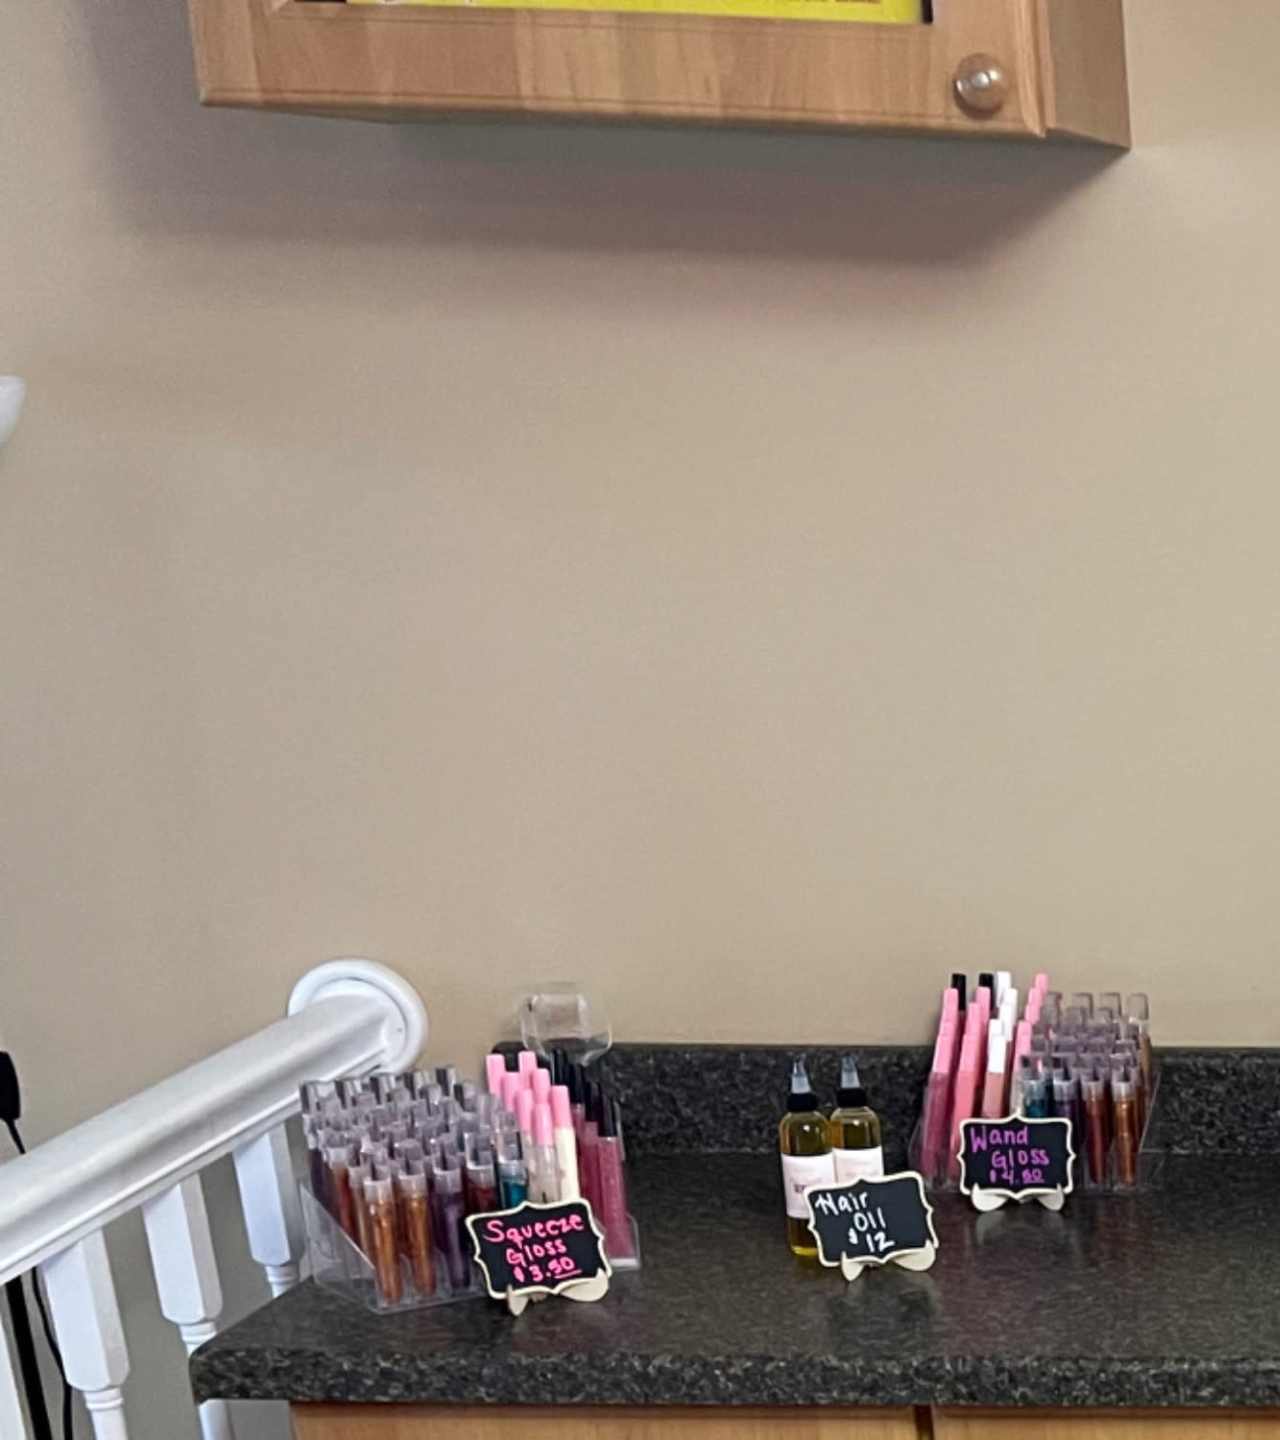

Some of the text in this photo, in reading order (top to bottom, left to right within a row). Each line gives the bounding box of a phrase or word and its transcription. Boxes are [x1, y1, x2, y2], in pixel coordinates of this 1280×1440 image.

[970, 1125, 1029, 1153] Wand
[992, 1148, 1050, 1169] Gloss
[815, 1191, 868, 1216] Hair
[482, 1214, 584, 1249] Squeeze
[506, 1239, 567, 1268] Gloss
